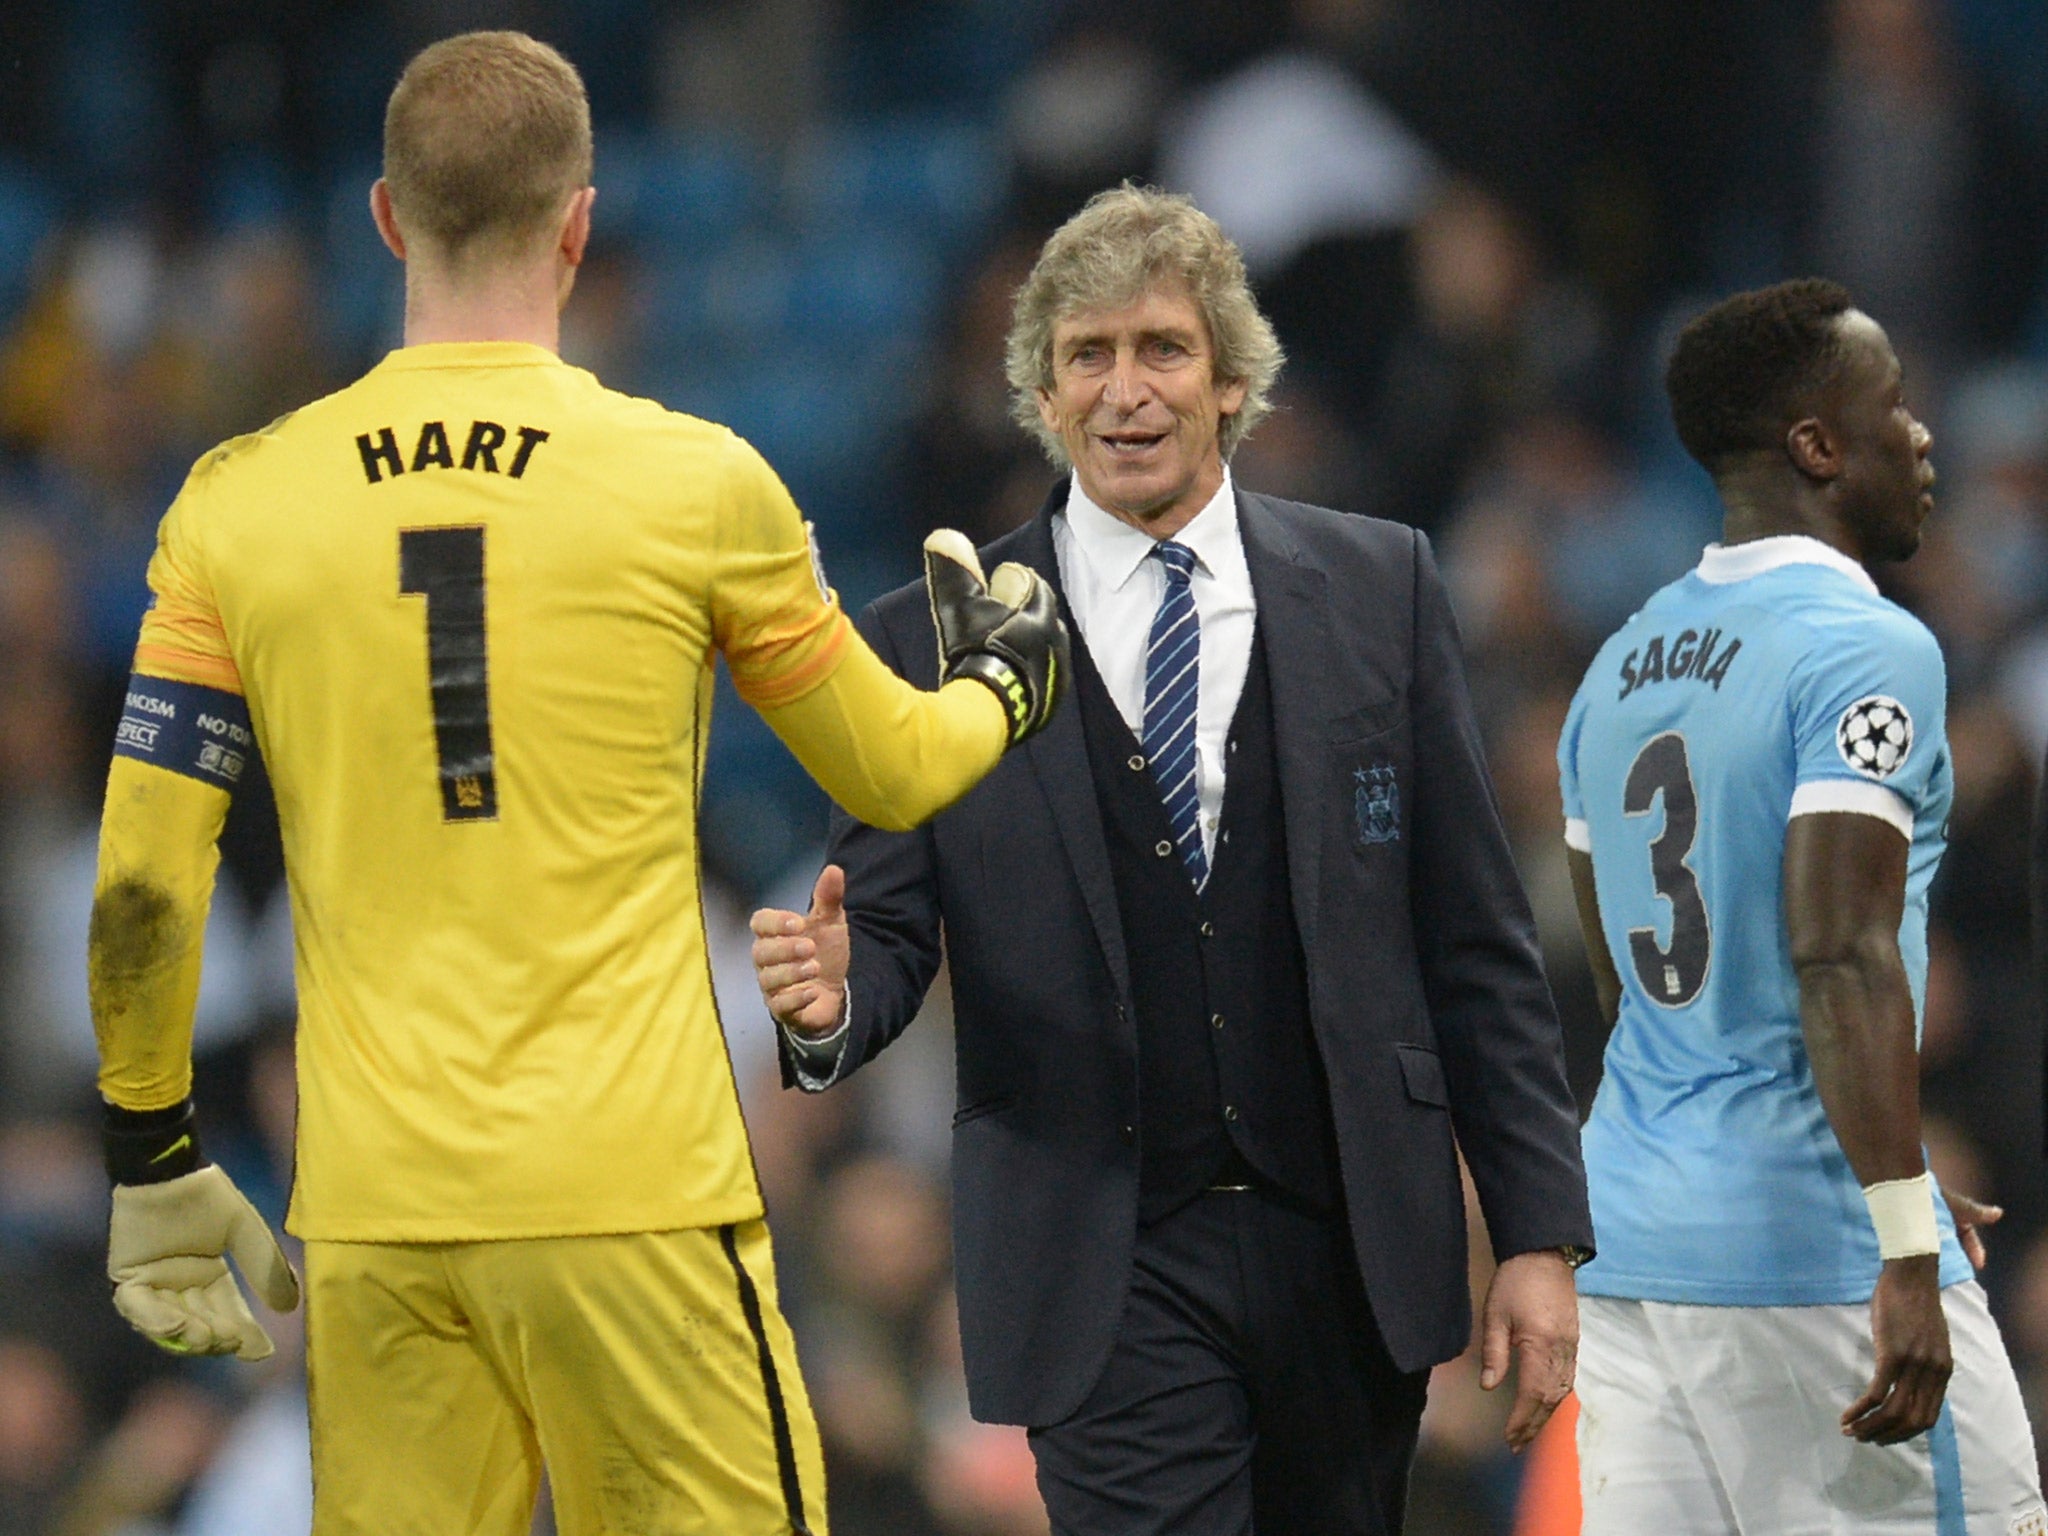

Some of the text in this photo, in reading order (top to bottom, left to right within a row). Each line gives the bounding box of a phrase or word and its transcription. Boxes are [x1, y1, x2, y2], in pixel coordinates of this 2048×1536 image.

[355, 422, 549, 483] HART
[398, 525, 499, 822] 1
[1619, 628, 1743, 701] SAGNA
[196, 713, 227, 735] NO
[1623, 730, 1713, 1009] 3
